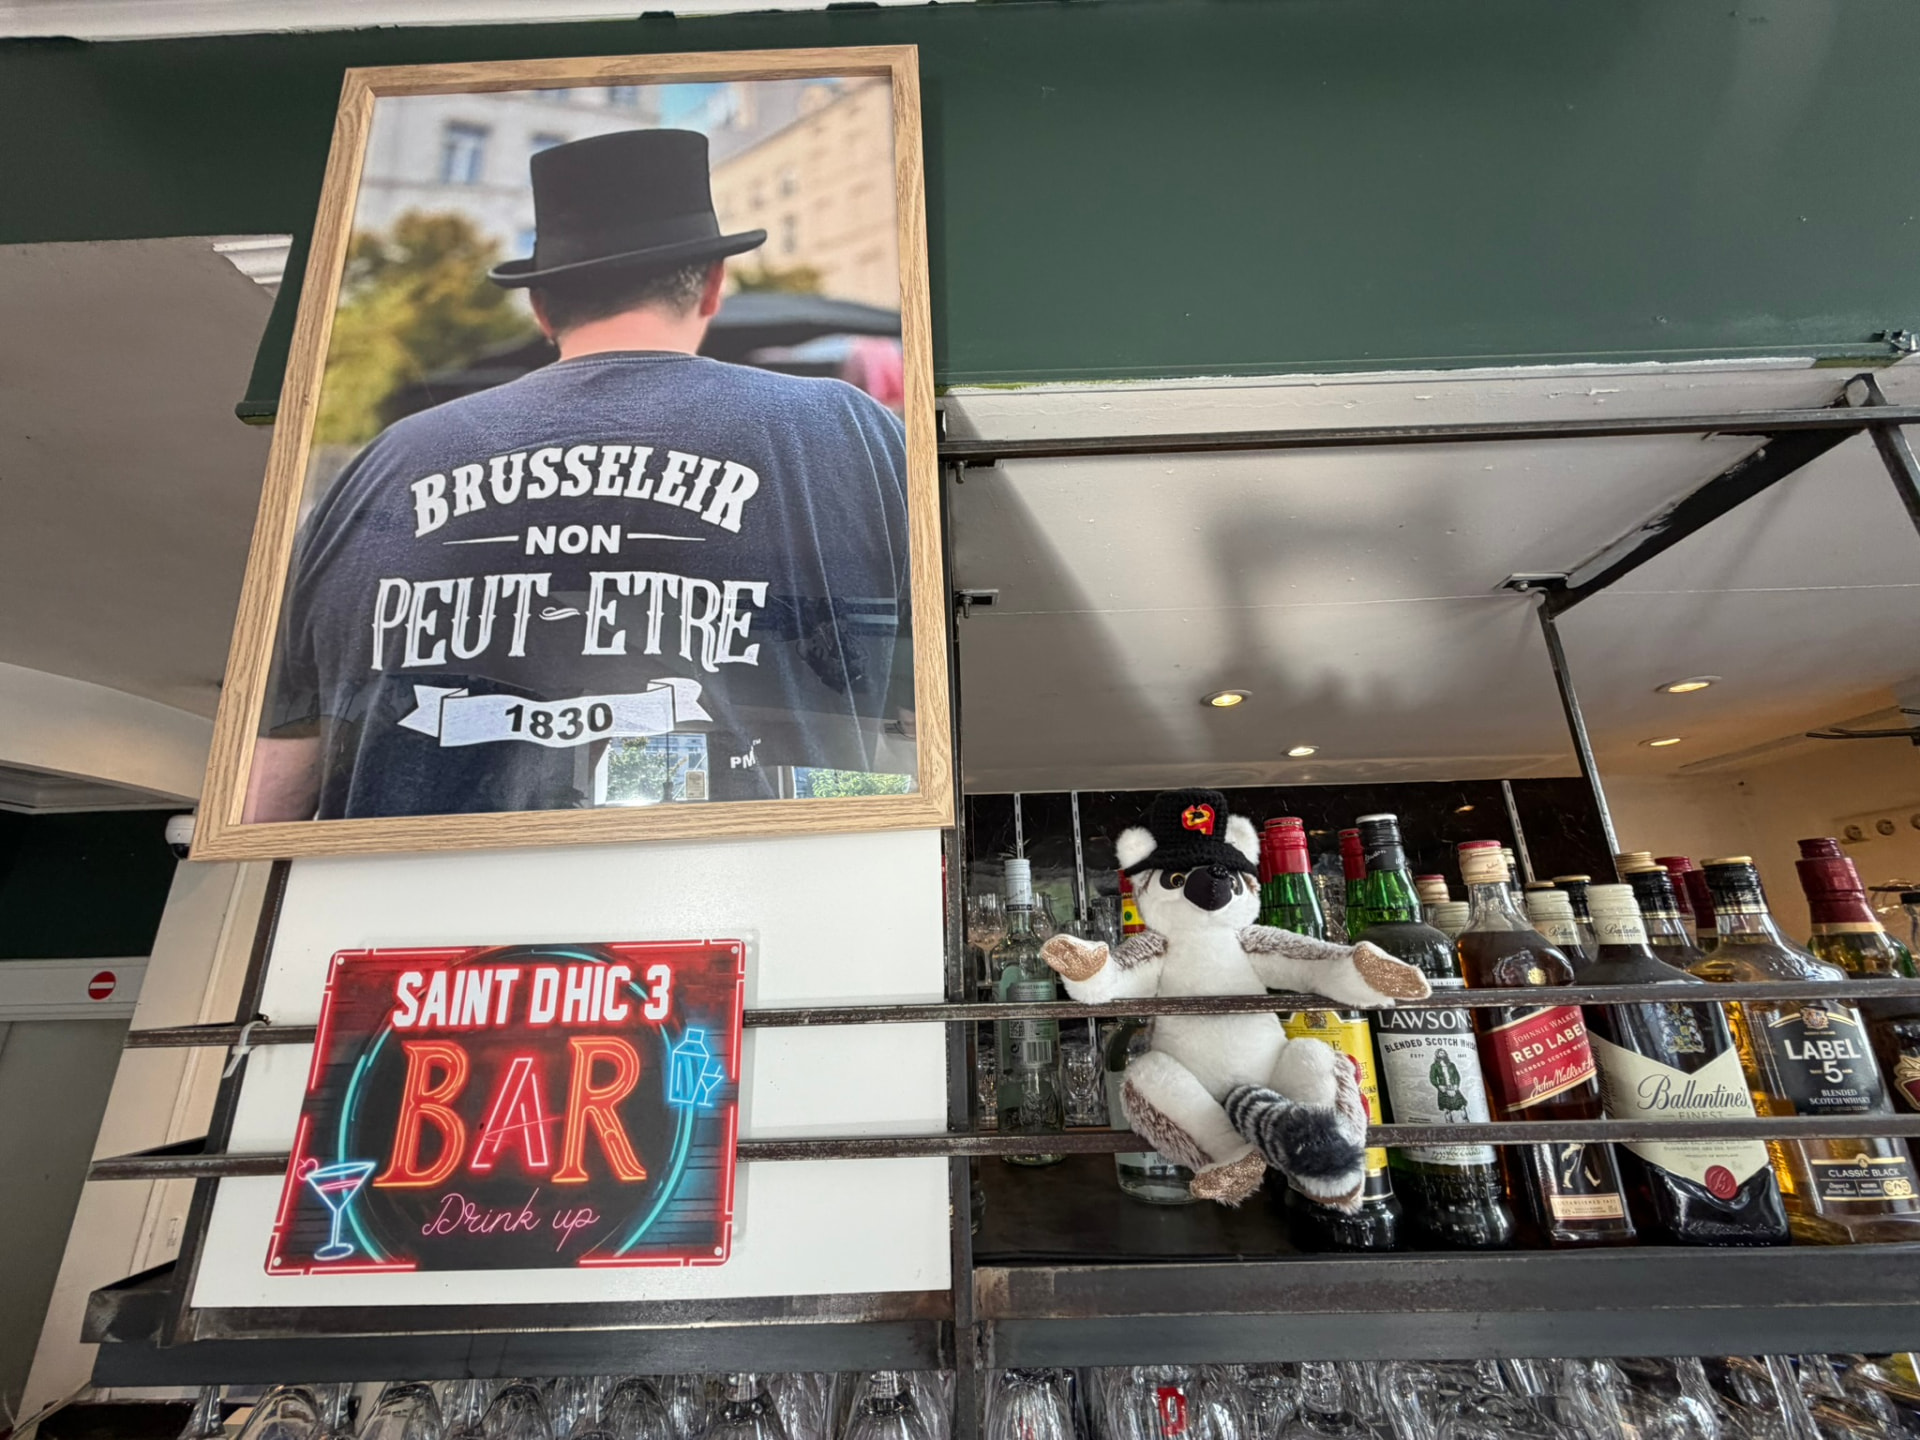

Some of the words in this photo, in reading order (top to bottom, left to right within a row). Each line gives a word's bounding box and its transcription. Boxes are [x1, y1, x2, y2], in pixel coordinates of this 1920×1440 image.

[411, 445, 760, 538] BRUSSELEIR
[525, 525, 622, 555] NON
[504, 702, 614, 740] 1830
[393, 968, 519, 1028] SAINT
[644, 964, 670, 1019] 3
[1384, 1038, 1423, 1053] BLENDED
[1424, 1037, 1458, 1047] SCOTCH
[1513, 1024, 1550, 1047] JOHNNIE
[1511, 1042, 1545, 1064] RED
[1784, 1038, 1862, 1060] LABEL
[1823, 1060, 1844, 1084] 5
[1530, 1075, 1556, 1098] John
[1636, 1073, 1749, 1111] Ballantine's
[1821, 1089, 1858, 1097] BLENDED
[372, 1036, 646, 1188] BAR
[1809, 1097, 1844, 1105] SCOTCH
[1828, 1169, 1870, 1178] CLASSIC
[1870, 1168, 1900, 1177] BLACK
[422, 1187, 542, 1237] Drink
[553, 1201, 600, 1253] up
